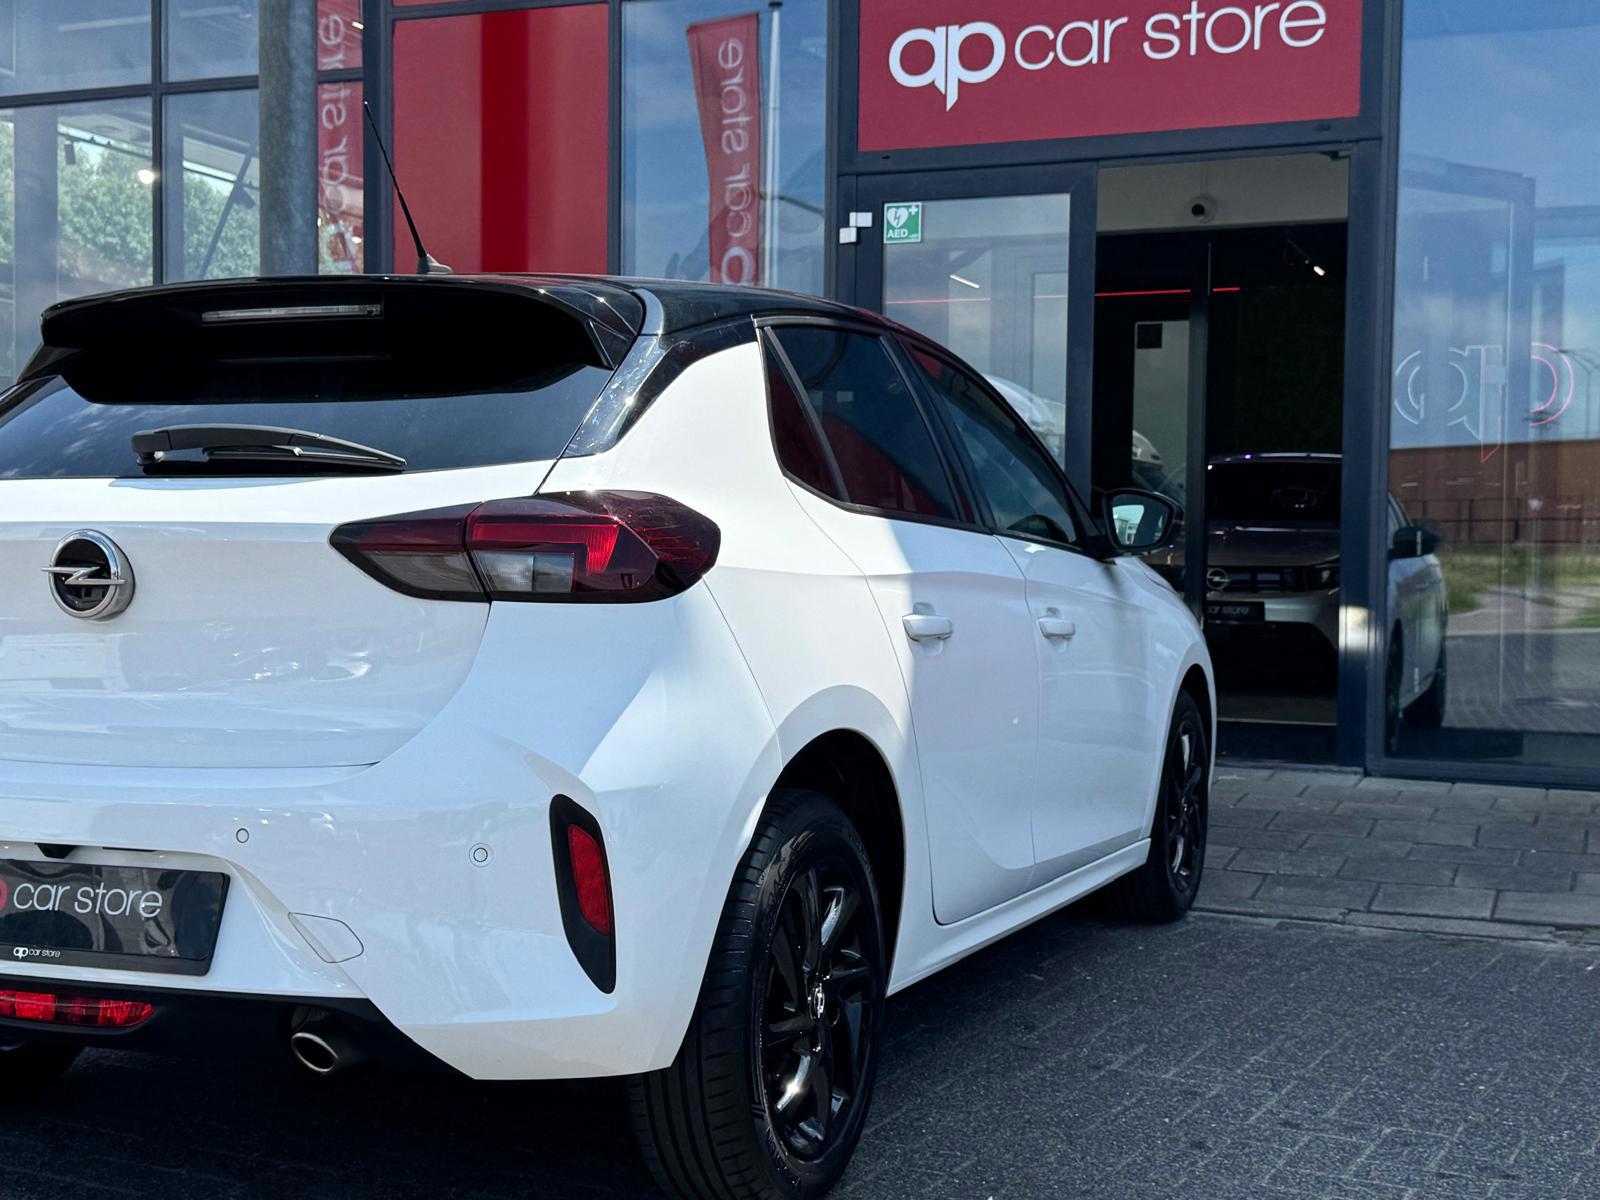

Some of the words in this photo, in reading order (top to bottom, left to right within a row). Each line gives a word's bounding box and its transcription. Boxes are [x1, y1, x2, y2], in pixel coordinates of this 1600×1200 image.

[889, 22, 1006, 112] ap
[1014, 16, 1128, 71] car
[1143, 0, 1326, 60] store
[887, 229, 909, 238] AED
[13, 883, 70, 911] car
[74, 882, 162, 918] store
[41, 949, 61, 958] store
